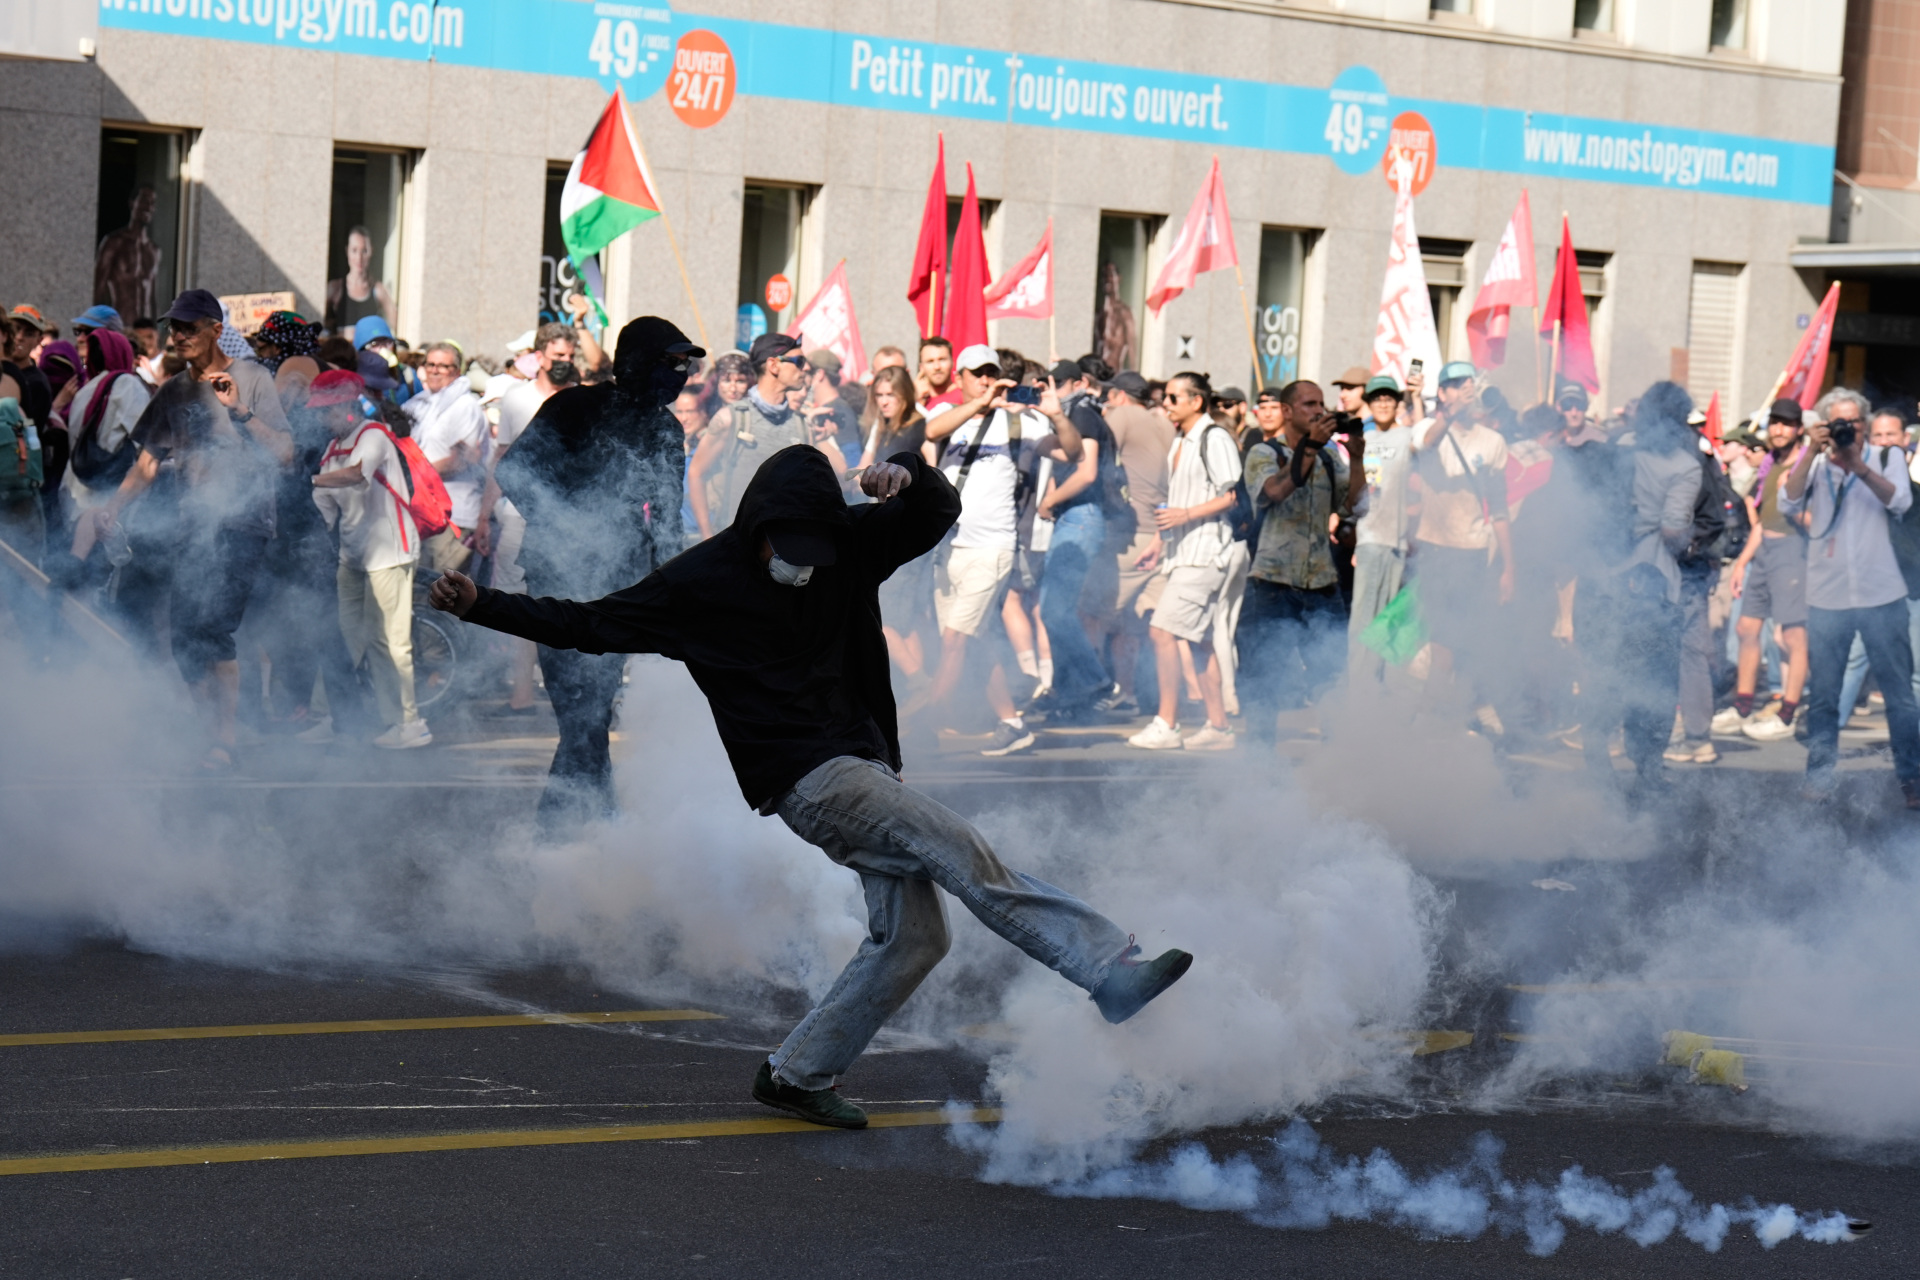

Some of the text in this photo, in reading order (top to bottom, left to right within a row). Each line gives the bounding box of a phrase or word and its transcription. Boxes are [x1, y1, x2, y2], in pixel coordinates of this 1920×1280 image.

[676, 48, 728, 75] OUVERT
[673, 71, 726, 111] 24/7
[850, 39, 1229, 131] Petit prix. Toujours ouvert.
[1387, 148, 1428, 183] 2/7
[1524, 128, 1779, 188] www.nonstopgym.com
